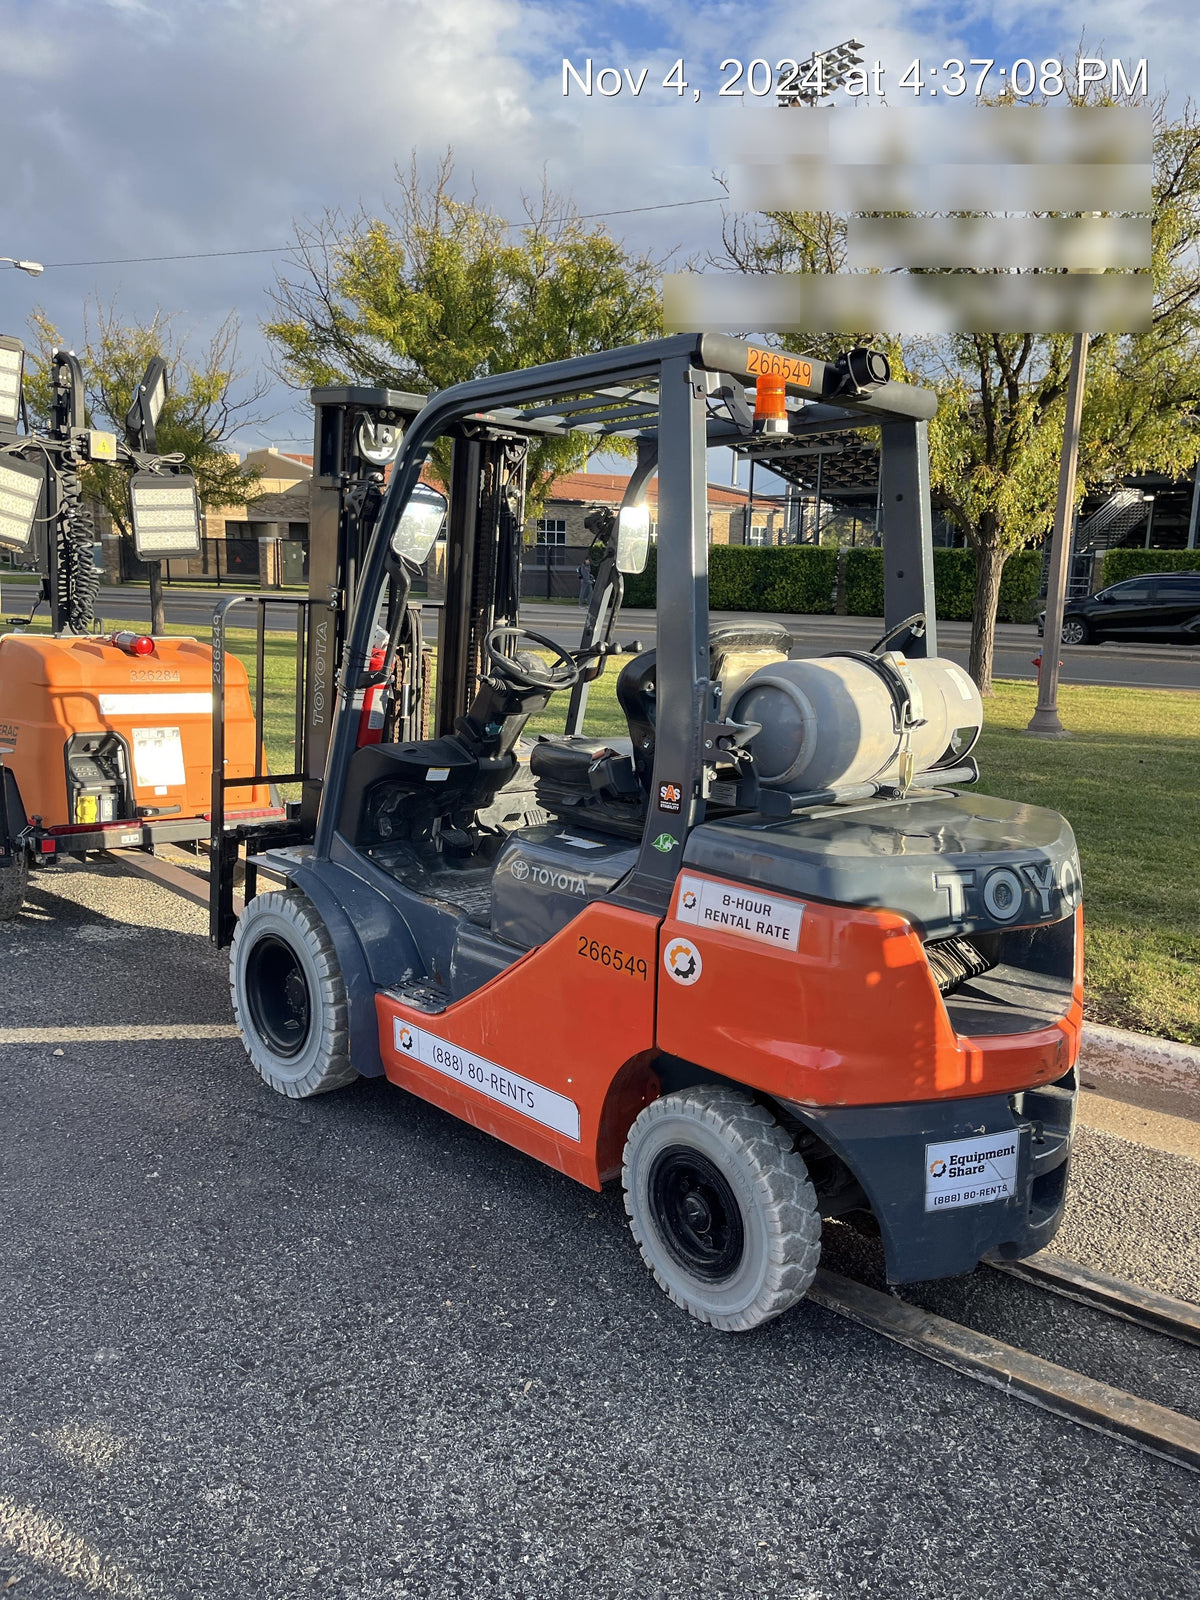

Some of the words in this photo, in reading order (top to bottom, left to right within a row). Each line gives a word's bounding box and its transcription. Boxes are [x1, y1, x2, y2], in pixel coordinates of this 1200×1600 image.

[748, 349, 812, 385] 266549
[213, 614, 221, 684] 266549
[130, 669, 180, 681] 326284
[312, 621, 328, 726] TOYOTA
[660, 784, 681, 802] SAS
[531, 866, 586, 895] TOYOTA
[722, 894, 772, 917] 8-HOUR
[704, 907, 752, 930] RENTAL
[756, 921, 791, 941] RATE
[577, 936, 647, 981] 266549
[432, 1045, 464, 1076] (888)
[468, 1063, 535, 1109] 80-RENTS
[949, 1145, 1016, 1167] Equipment
[948, 1164, 985, 1178] Share
[934, 1194, 961, 1206] (888)
[963, 1184, 1008, 1200] 80-RENTS
